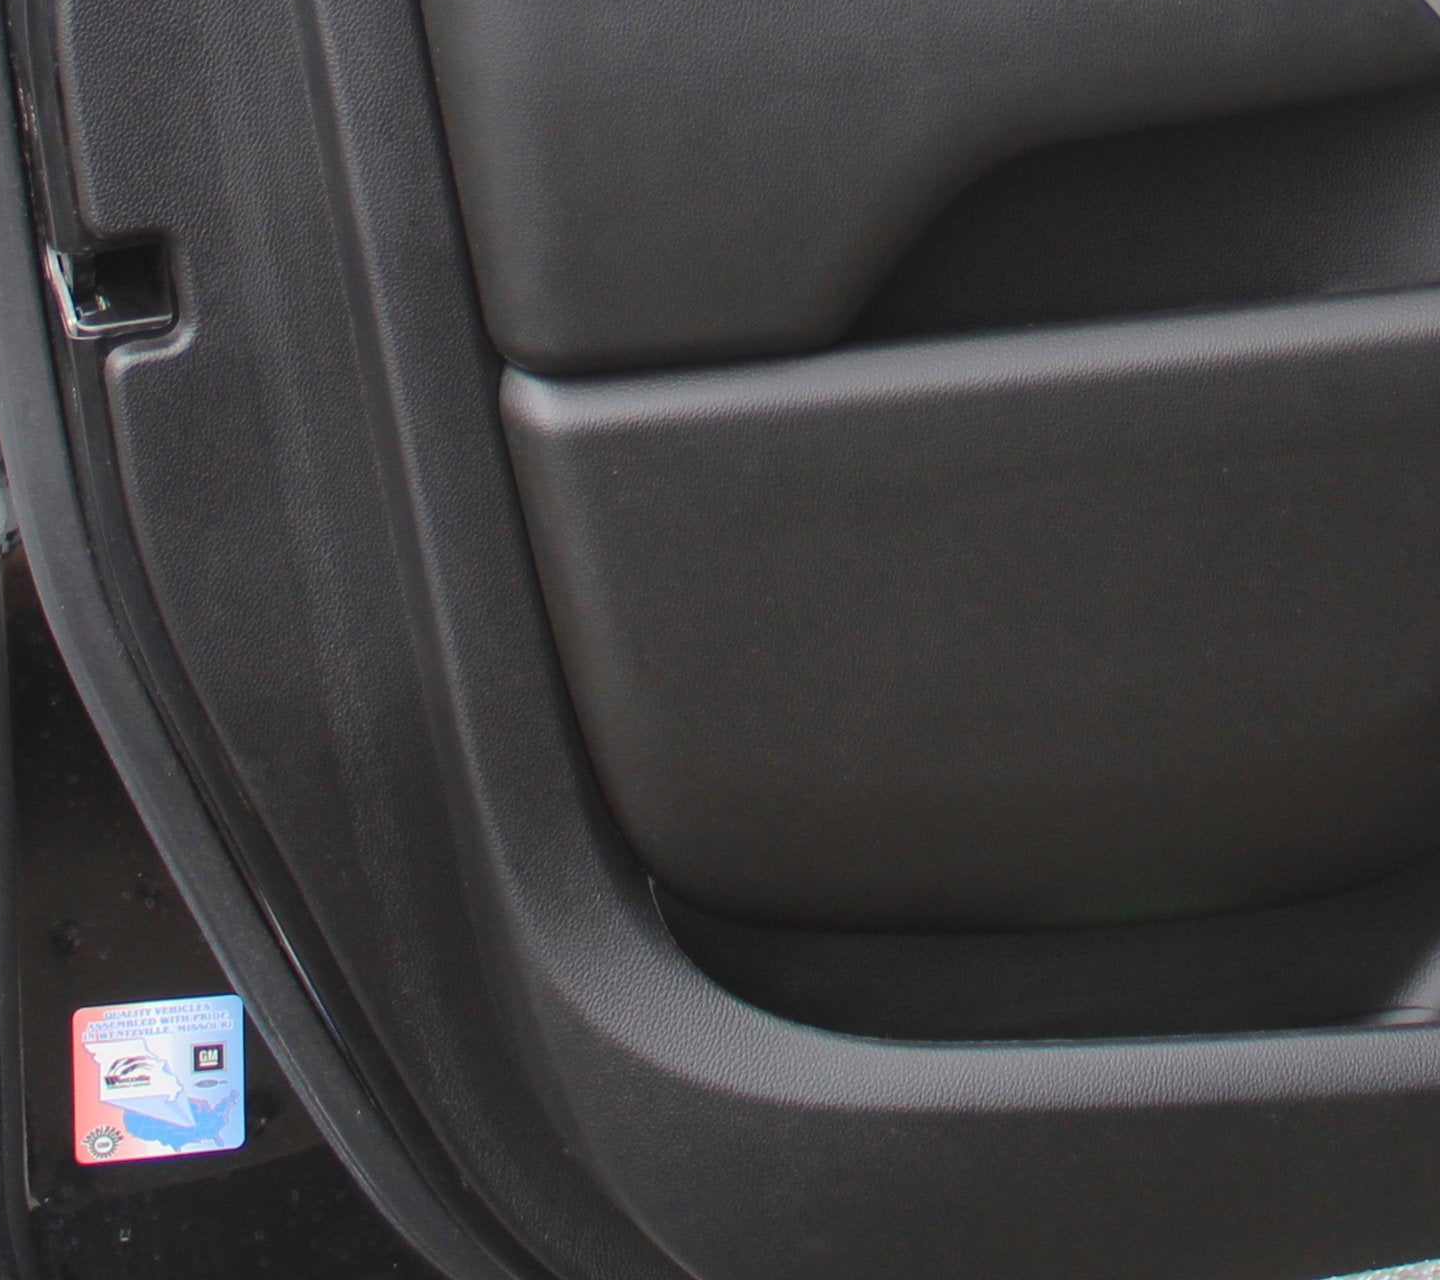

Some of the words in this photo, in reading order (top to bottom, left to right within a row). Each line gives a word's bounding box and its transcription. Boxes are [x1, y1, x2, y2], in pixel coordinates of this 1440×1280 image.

[104, 1008, 152, 1019] QUALITY
[155, 1003, 210, 1015] VEHICLES
[88, 1018, 157, 1030] ASSEMBLED
[199, 1048, 219, 1062] GM
